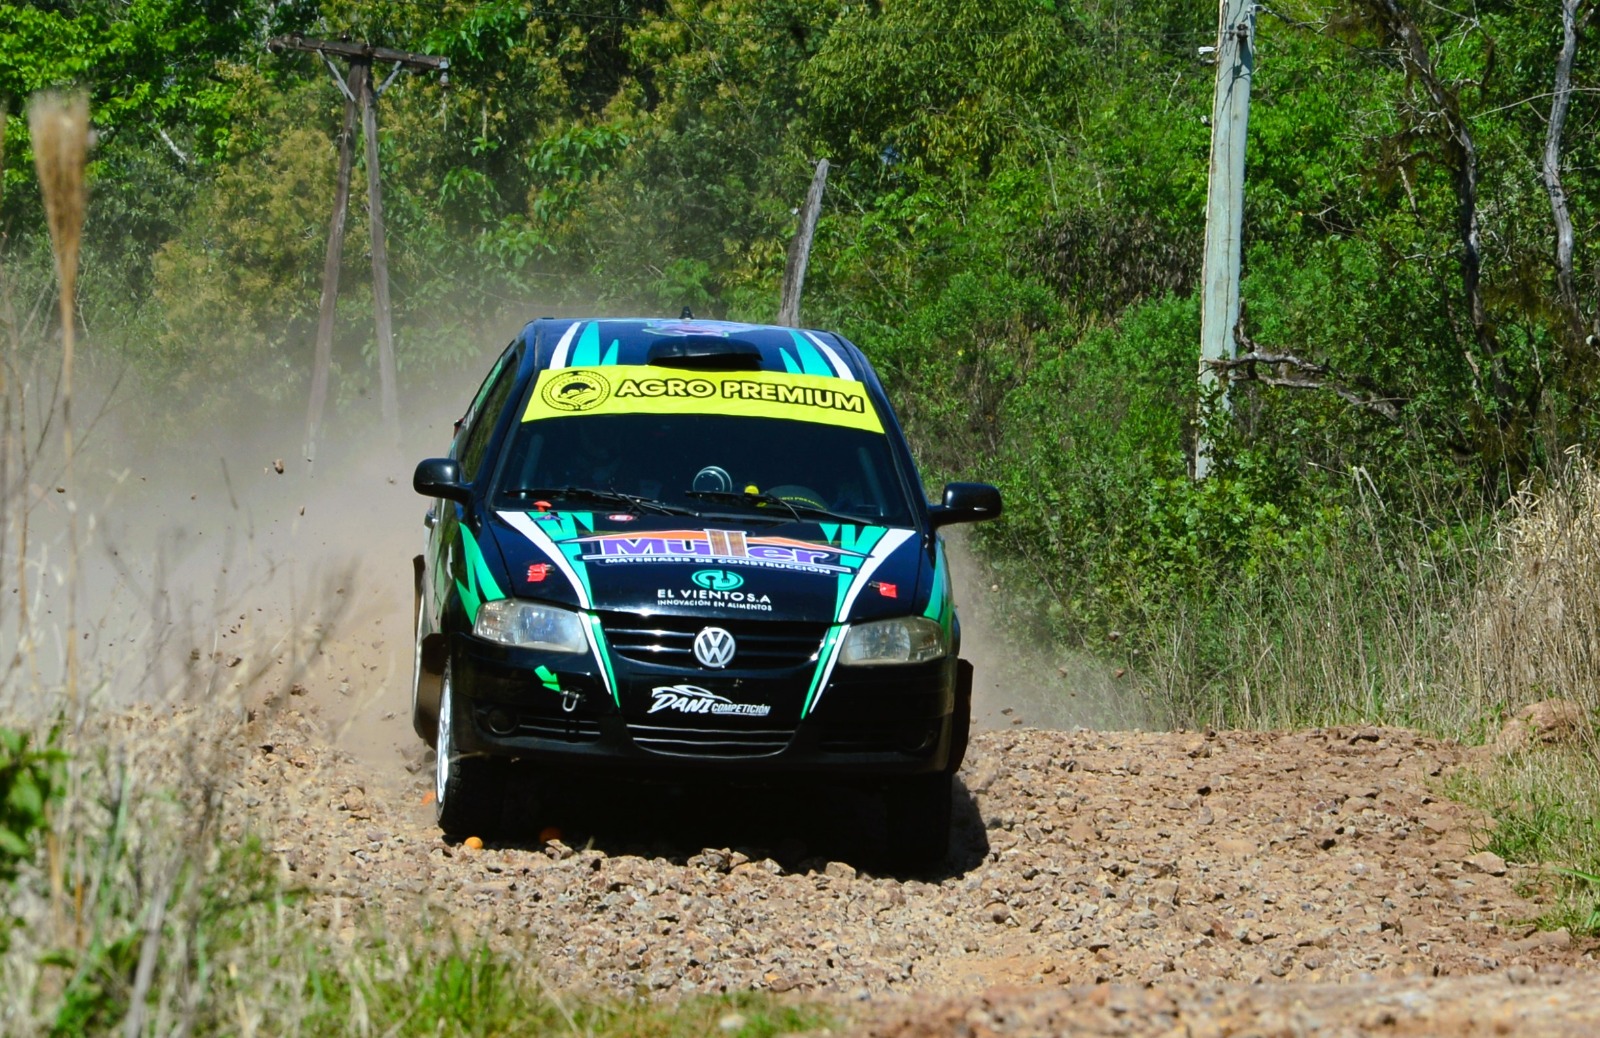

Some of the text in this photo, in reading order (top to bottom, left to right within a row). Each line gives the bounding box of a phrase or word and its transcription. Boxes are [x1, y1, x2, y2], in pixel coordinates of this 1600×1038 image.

[614, 378, 865, 413] AGRO PREMIUM
[657, 589, 675, 598] EL
[657, 598, 711, 606] INNOVACIÓN
[727, 602, 772, 611] ALIMENTOS
[647, 693, 771, 715] DANI COMPETICIÓN
